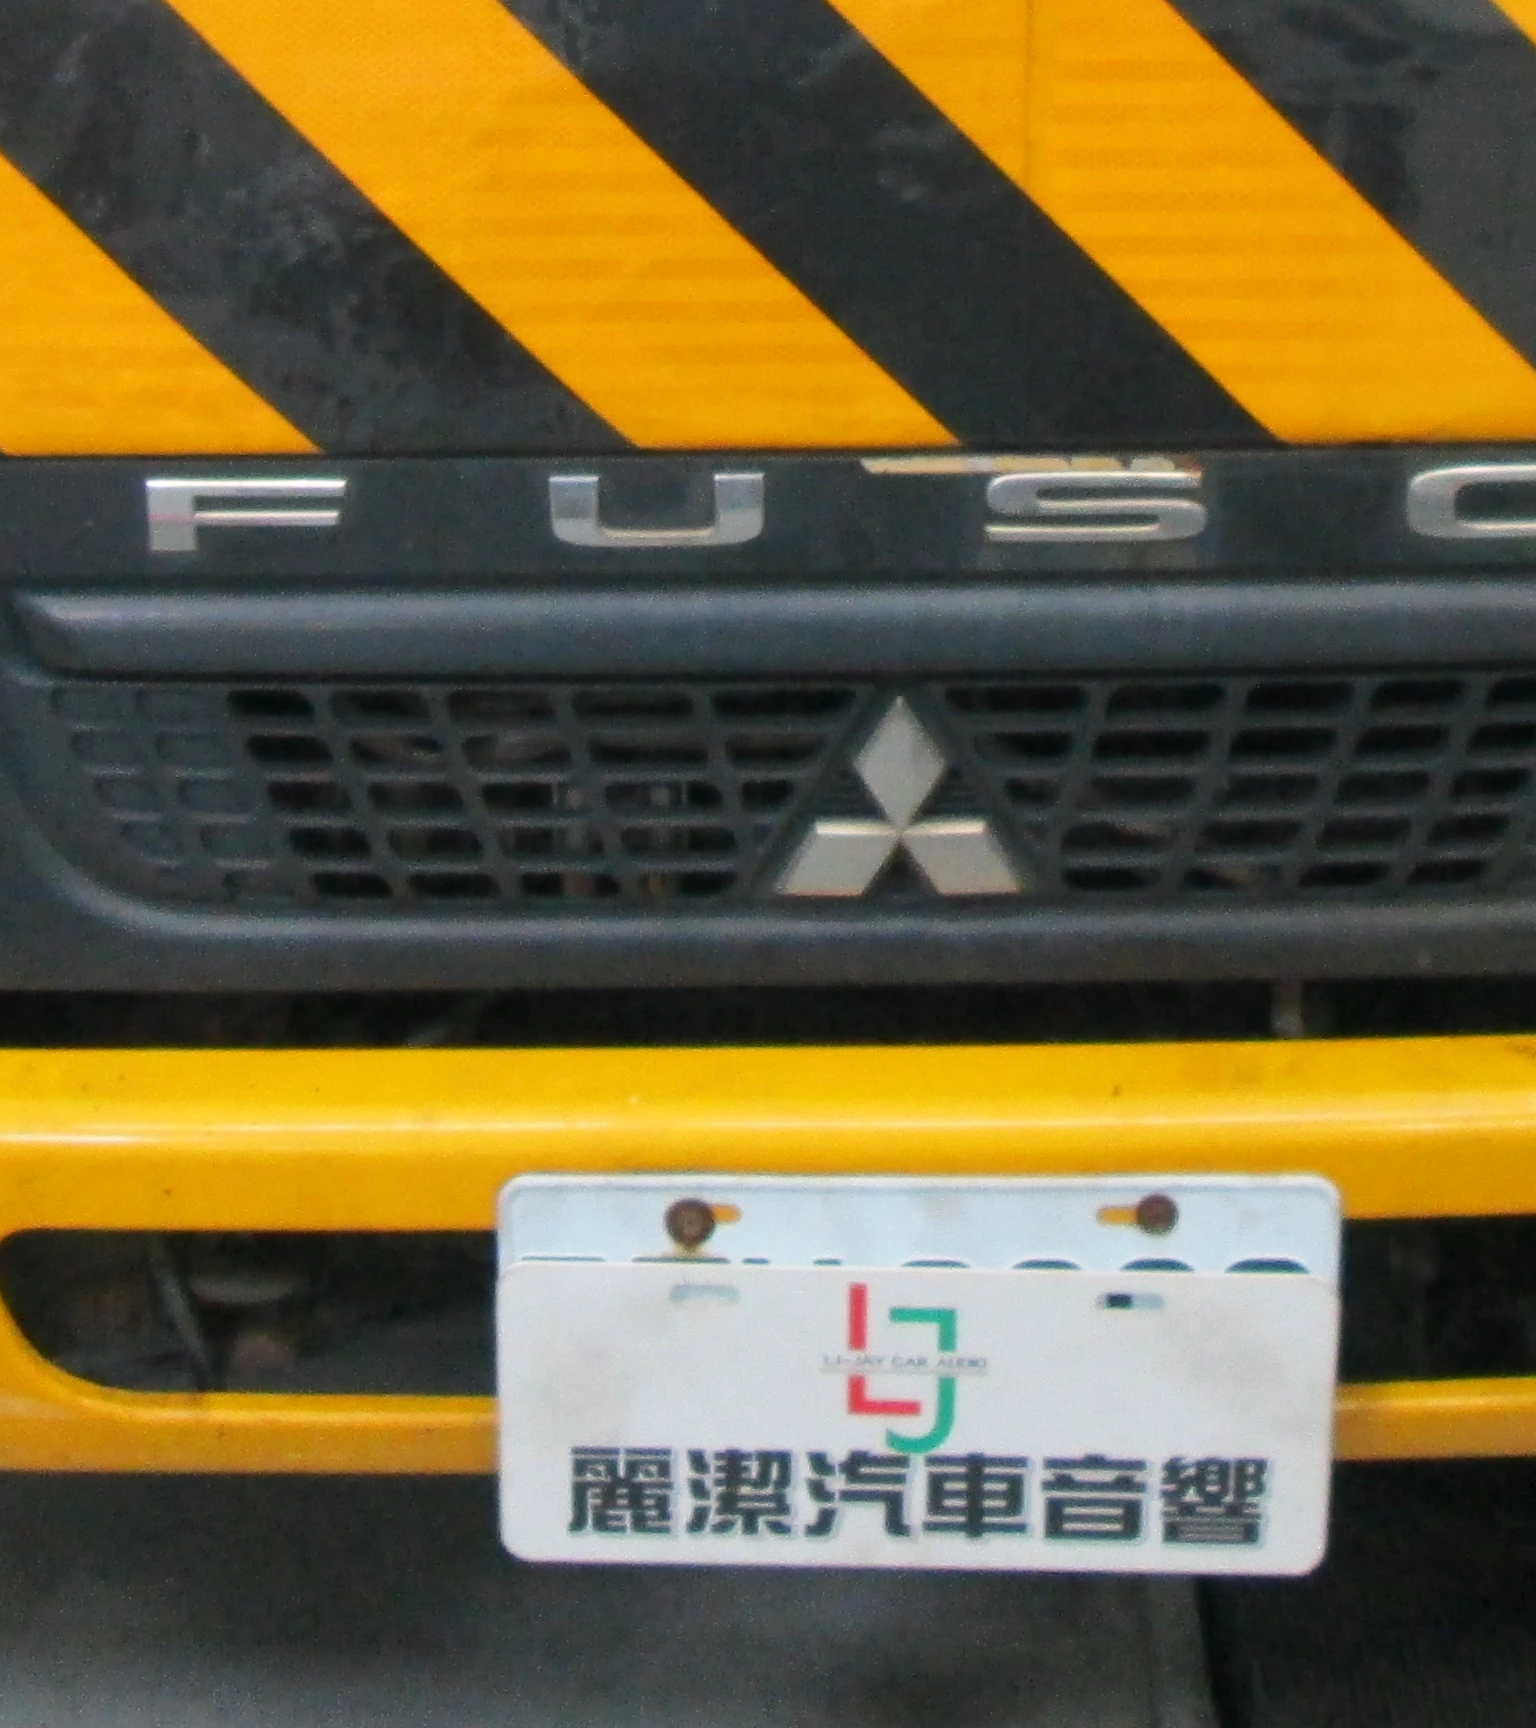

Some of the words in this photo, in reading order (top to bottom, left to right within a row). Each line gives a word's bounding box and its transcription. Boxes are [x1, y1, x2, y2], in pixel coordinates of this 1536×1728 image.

[890, 1354, 928, 1368] CAR
[936, 1355, 987, 1369] AUDIO
[568, 1445, 1269, 1547] 麗潔汽車音響
